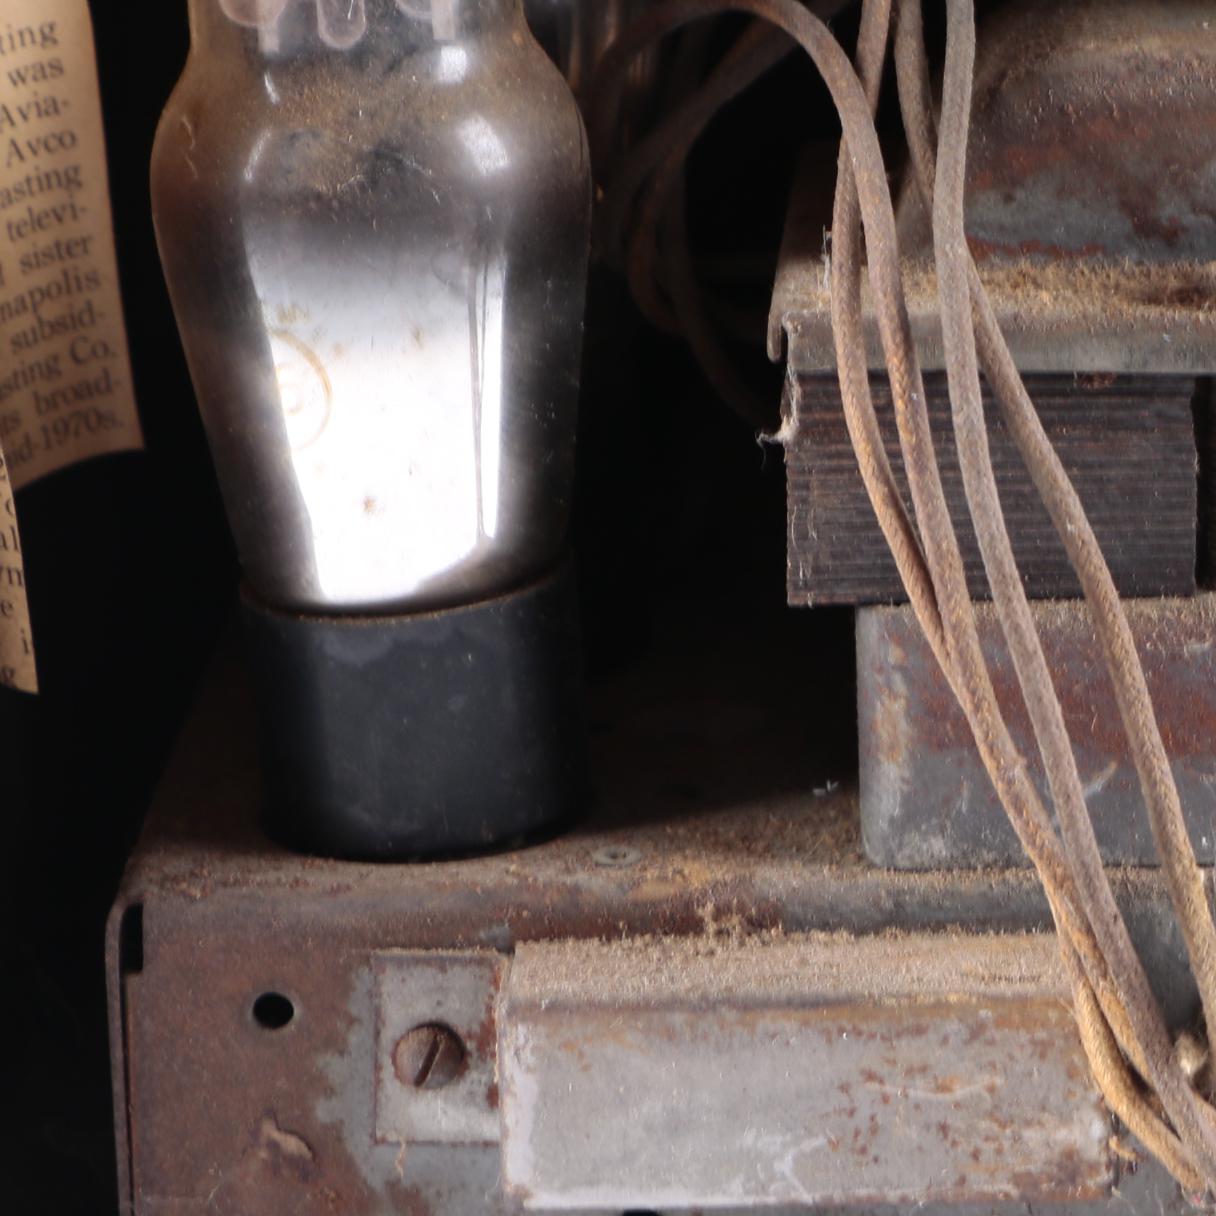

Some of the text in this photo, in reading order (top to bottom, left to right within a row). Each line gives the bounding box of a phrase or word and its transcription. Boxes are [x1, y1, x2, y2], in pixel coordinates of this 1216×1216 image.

[8, 57, 65, 88] was
[5, 129, 77, 168] Avco
[6, 190, 89, 242] televi-
[19, 235, 93, 274] sister
